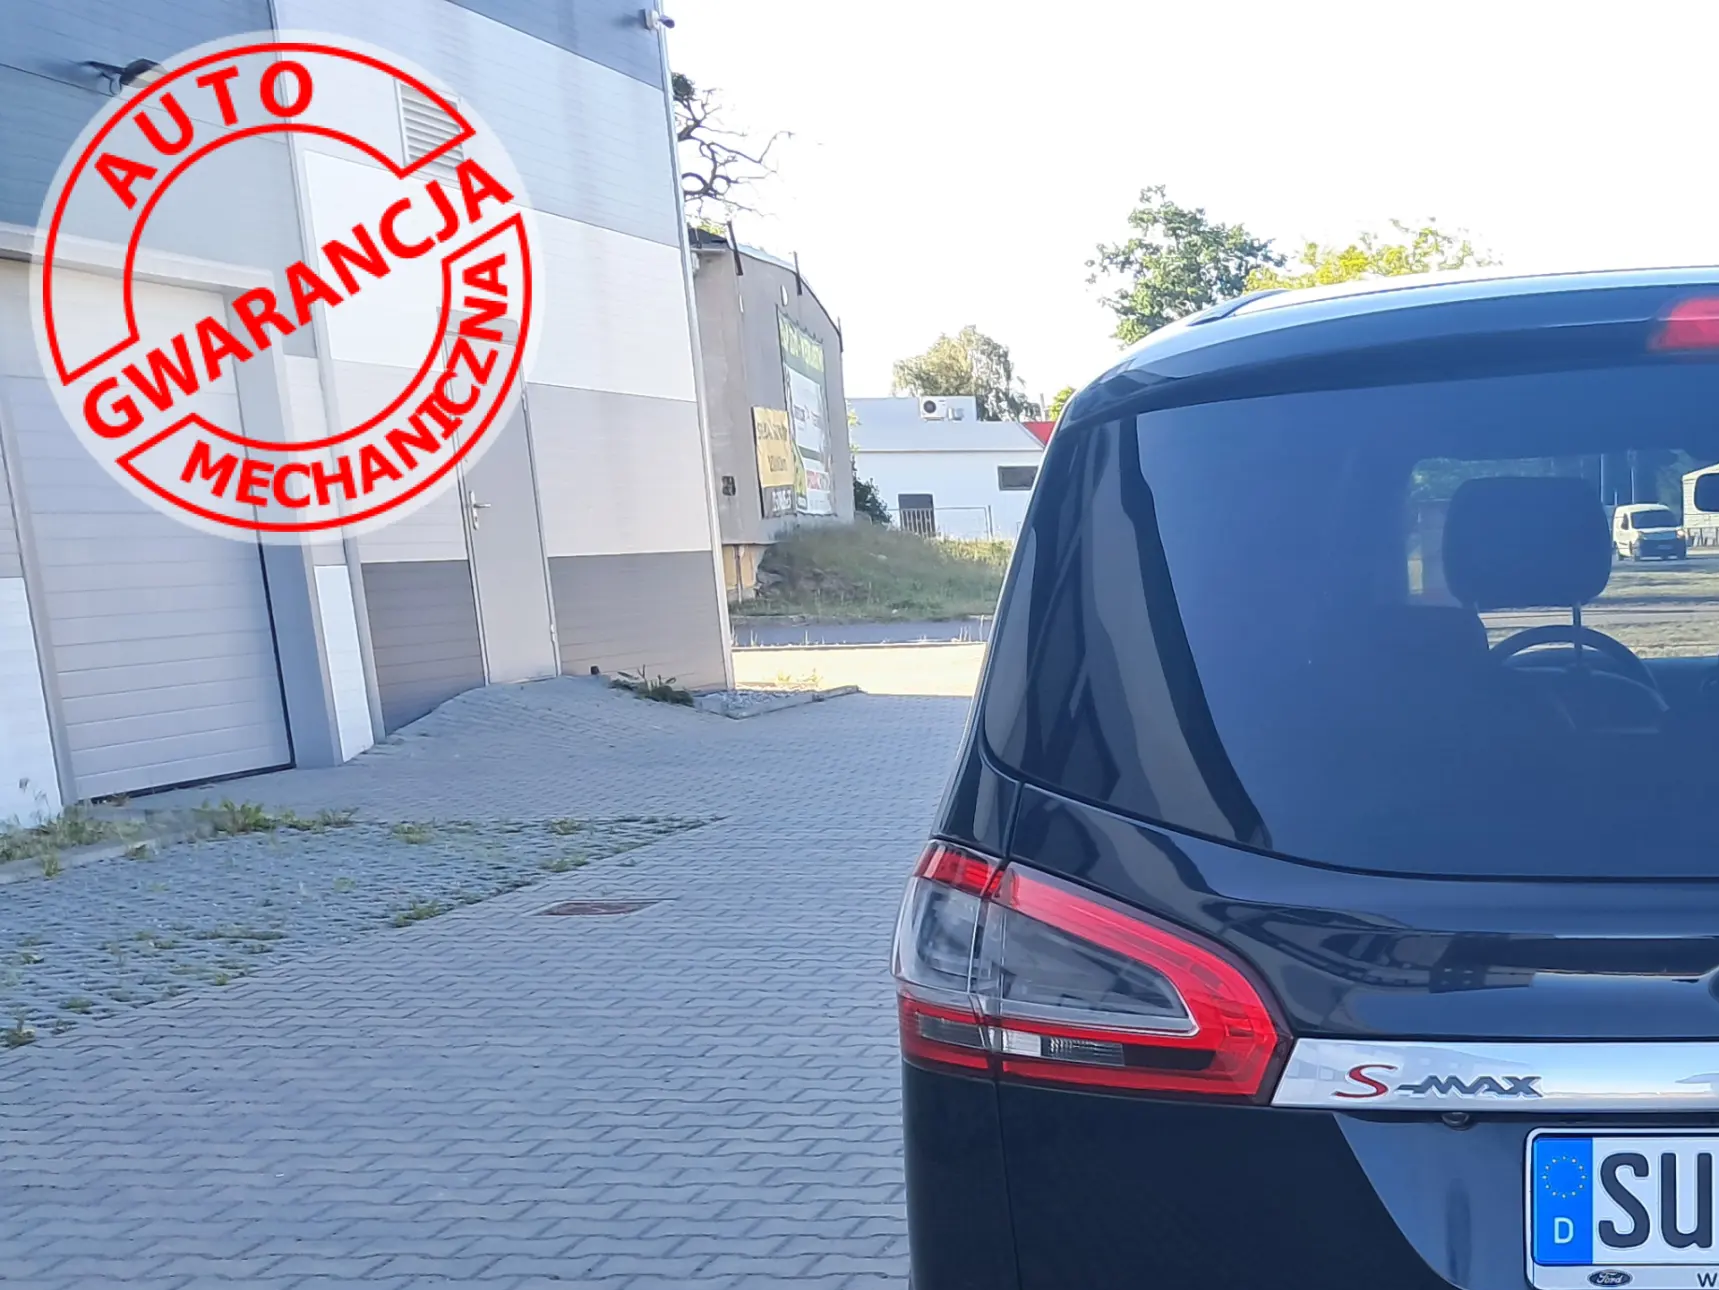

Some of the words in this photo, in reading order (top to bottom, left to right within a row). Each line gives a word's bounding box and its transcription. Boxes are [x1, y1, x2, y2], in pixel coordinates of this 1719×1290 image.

[1331, 1064, 1544, 1099] S-MAX
[1599, 1152, 1713, 1249] SU
[1553, 1217, 1575, 1244] D
[1596, 1271, 1623, 1284] Ford
